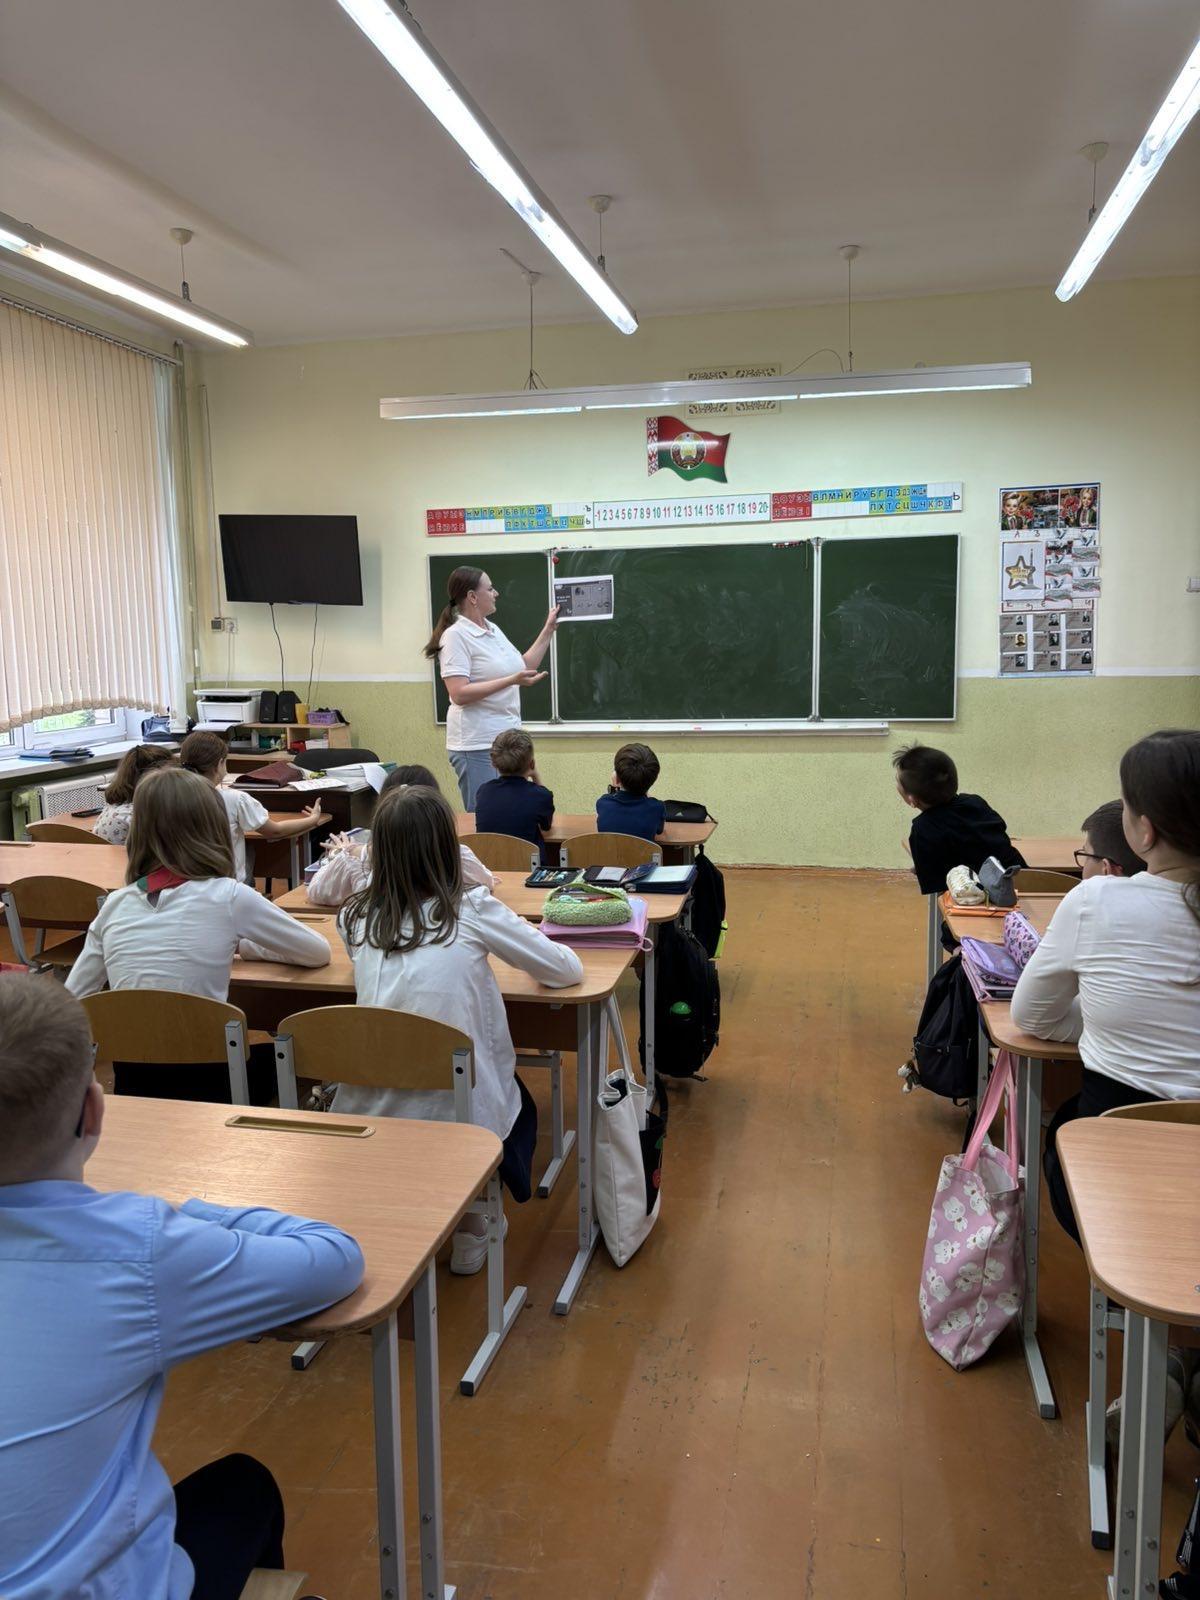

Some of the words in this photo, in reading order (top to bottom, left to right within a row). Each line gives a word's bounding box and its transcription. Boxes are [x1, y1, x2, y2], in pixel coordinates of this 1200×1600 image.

[653, 507, 661, 519] 10
[663, 506, 670, 518] 11
[674, 506, 681, 518] 12
[684, 505, 692, 517] 13
[695, 505, 703, 516] 14
[705, 504, 714, 516] 15
[716, 504, 724, 516] 16
[727, 503, 735, 515] 17
[738, 503, 746, 514] 18
[748, 502, 757, 514] 19
[759, 502, 767, 514] 20
